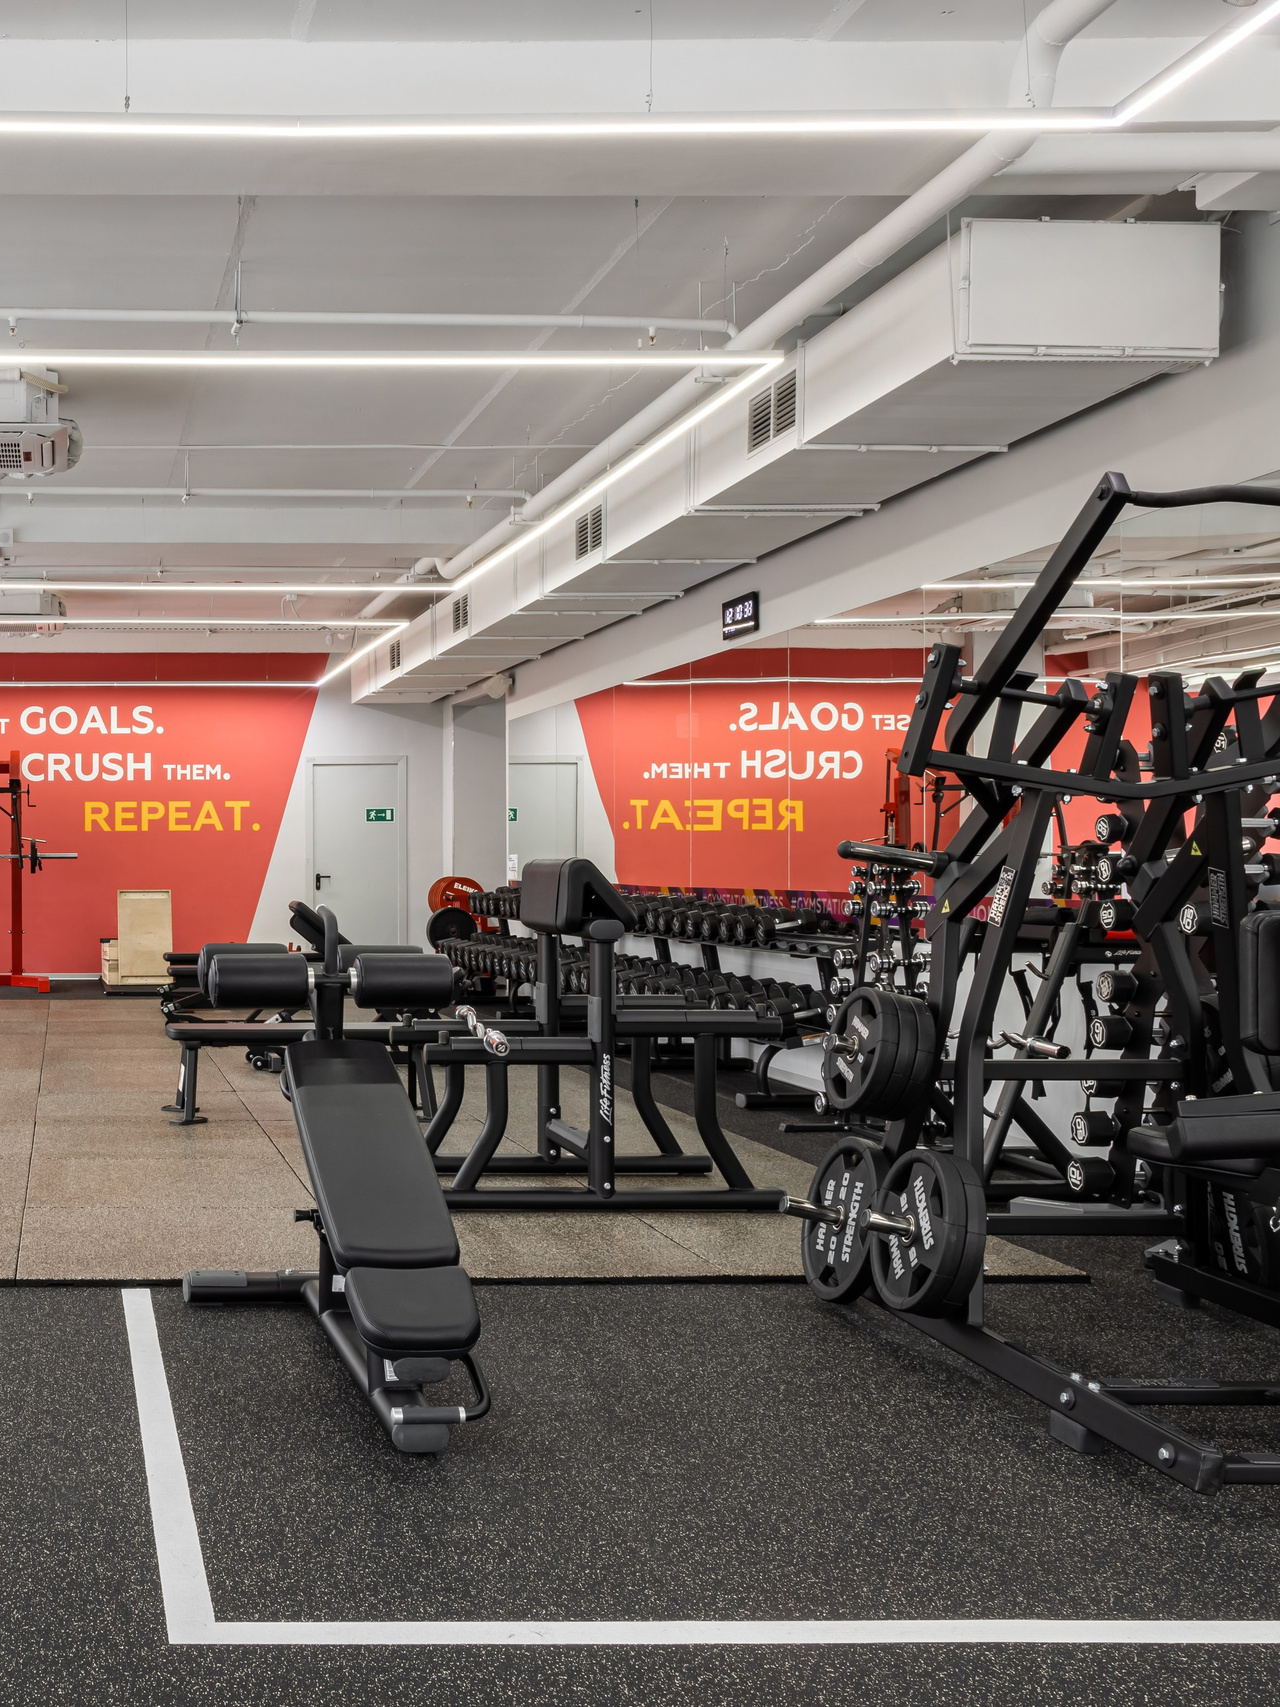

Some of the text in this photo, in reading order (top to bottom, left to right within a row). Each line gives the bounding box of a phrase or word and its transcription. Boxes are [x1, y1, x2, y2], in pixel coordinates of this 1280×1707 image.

[20, 705, 164, 735] GOALS.
[21, 752, 231, 782] CRUSH THEM.
[84, 800, 261, 832] REPEAT.
[599, 1053, 613, 1127] Life Fitness
[838, 1172, 850, 1201] 20
[899, 1192, 909, 1213] 15
[913, 1175, 935, 1250] STRENGTH
[841, 1181, 864, 1263] STRENGTH
[1222, 1191, 1248, 1275] STRENGTH
[827, 1236, 837, 1265] 20
[908, 1246, 918, 1268] 15
